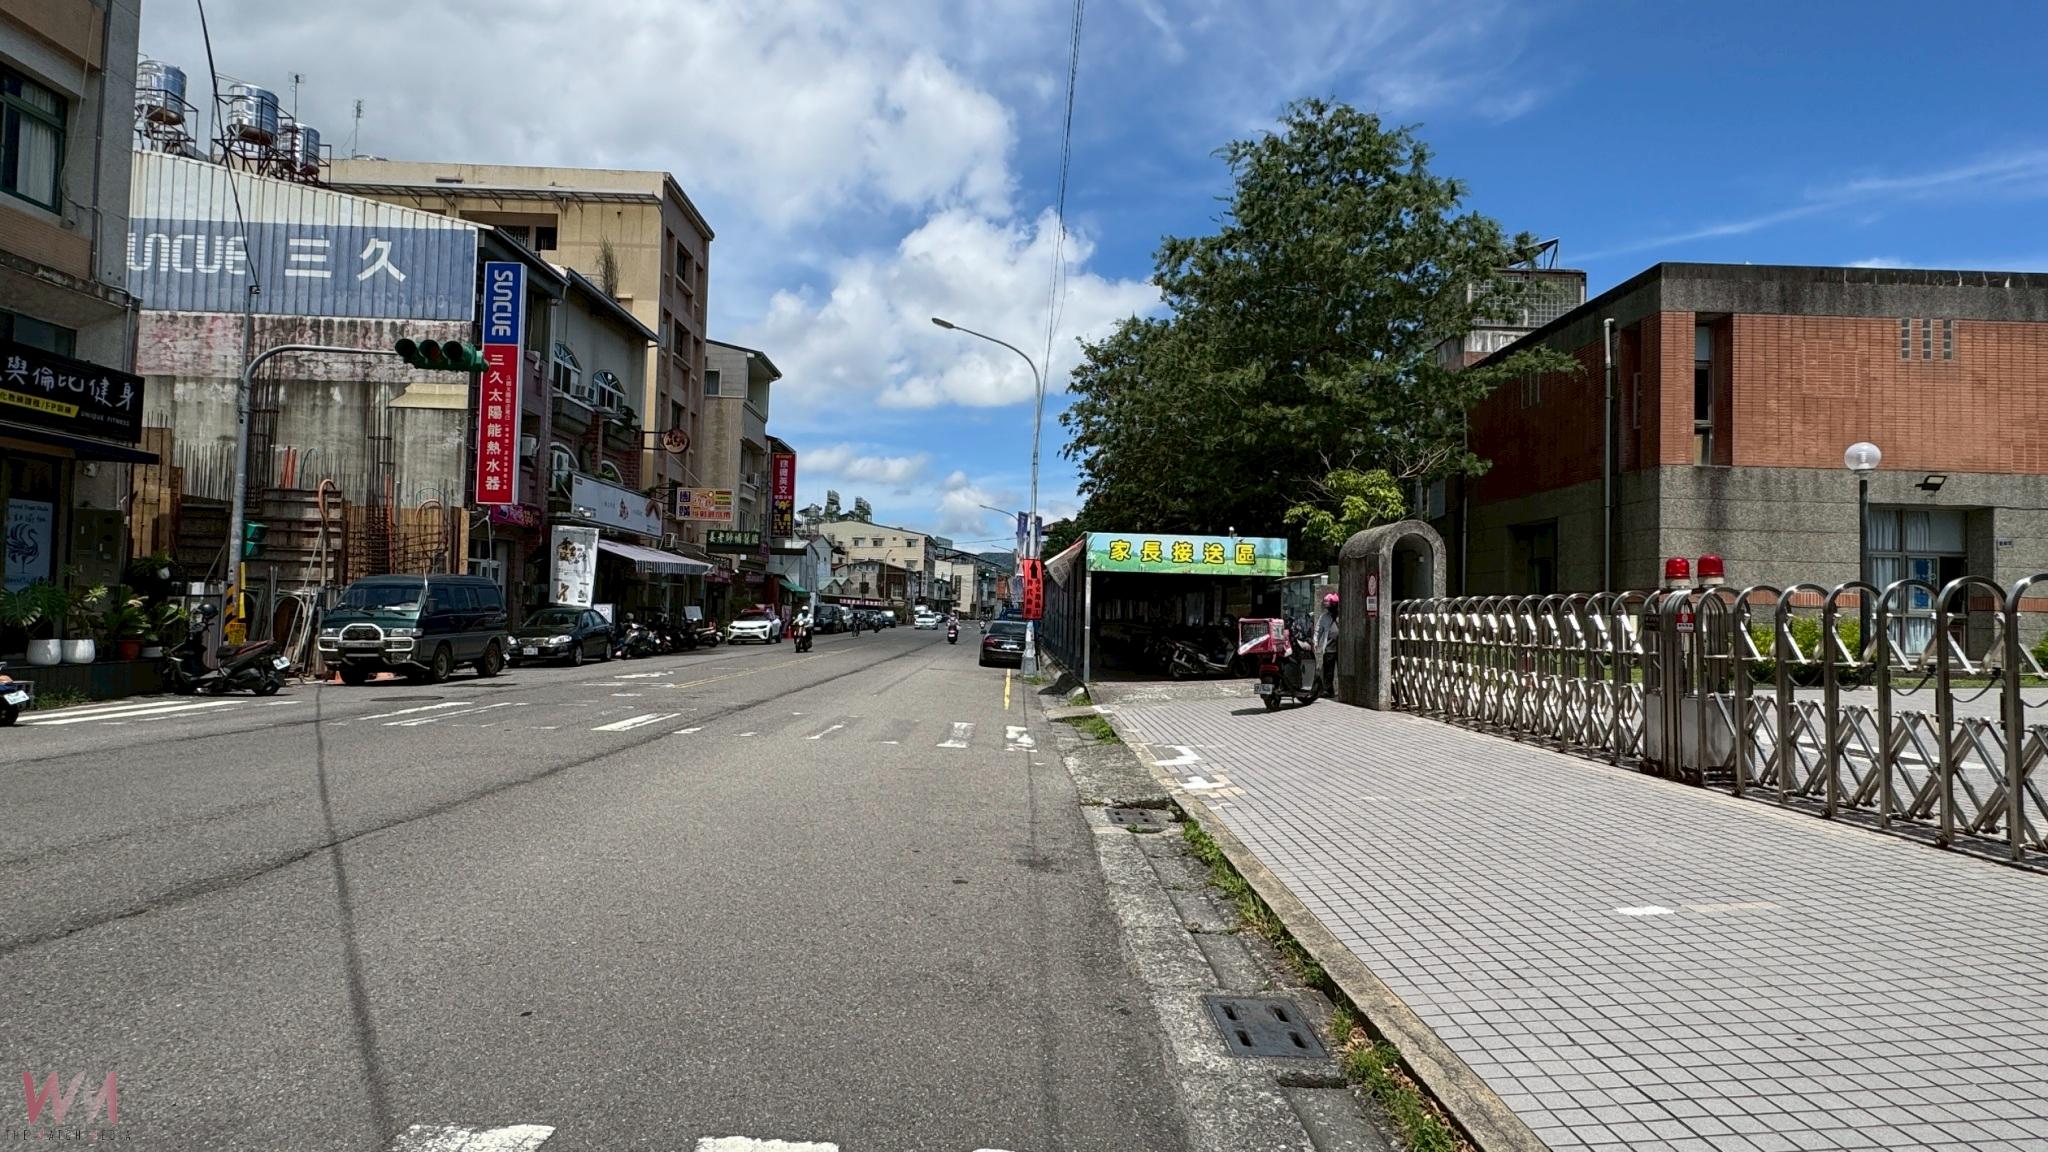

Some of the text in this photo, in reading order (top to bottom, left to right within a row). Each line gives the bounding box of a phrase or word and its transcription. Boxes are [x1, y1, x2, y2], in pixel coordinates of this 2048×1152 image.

[285, 237, 406, 282] 三久
[491, 269, 514, 337] SUNCUE
[0, 355, 135, 411] 與倫比健身
[485, 354, 504, 491] 三久太陽能熱水器
[1109, 539, 1256, 565] 家長接送區
